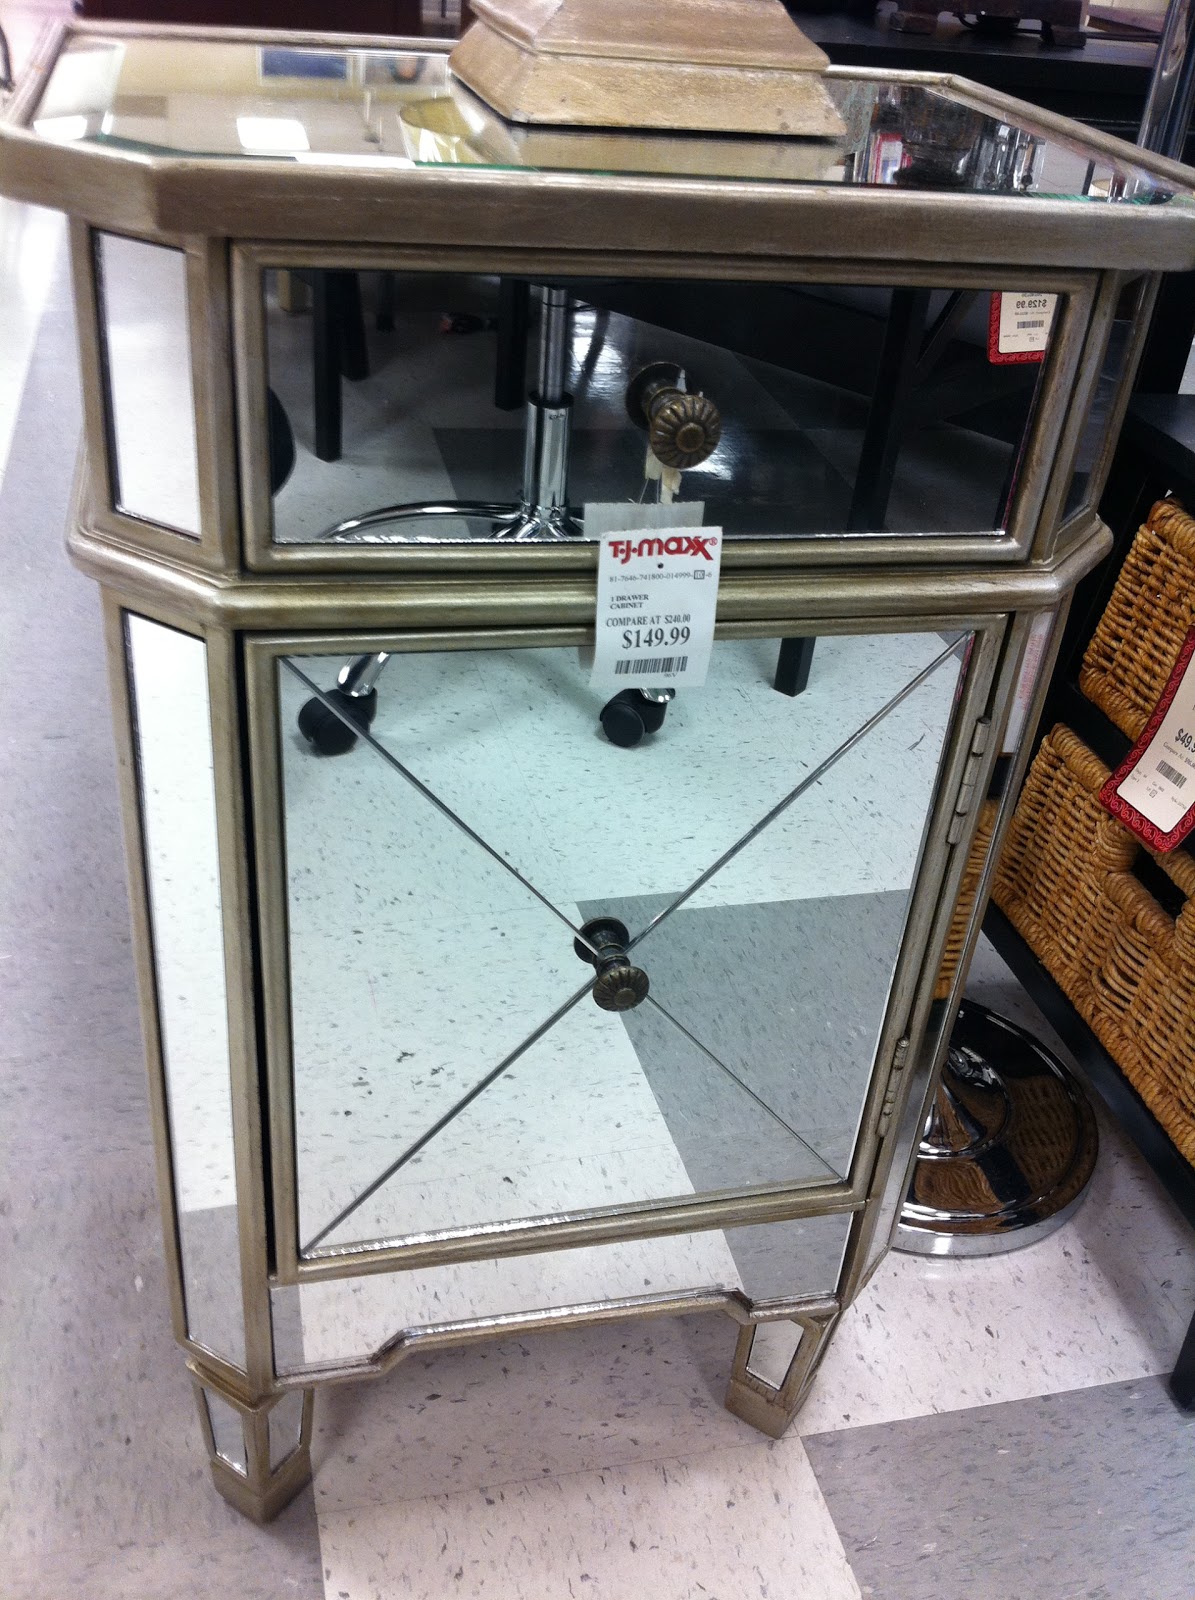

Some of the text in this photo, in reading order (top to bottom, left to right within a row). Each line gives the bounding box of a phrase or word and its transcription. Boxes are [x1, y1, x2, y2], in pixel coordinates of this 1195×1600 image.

[616, 594, 649, 602] DRAWER
[606, 614, 691, 627] COMPARE AT $240.00
[622, 627, 690, 649] $149.99
